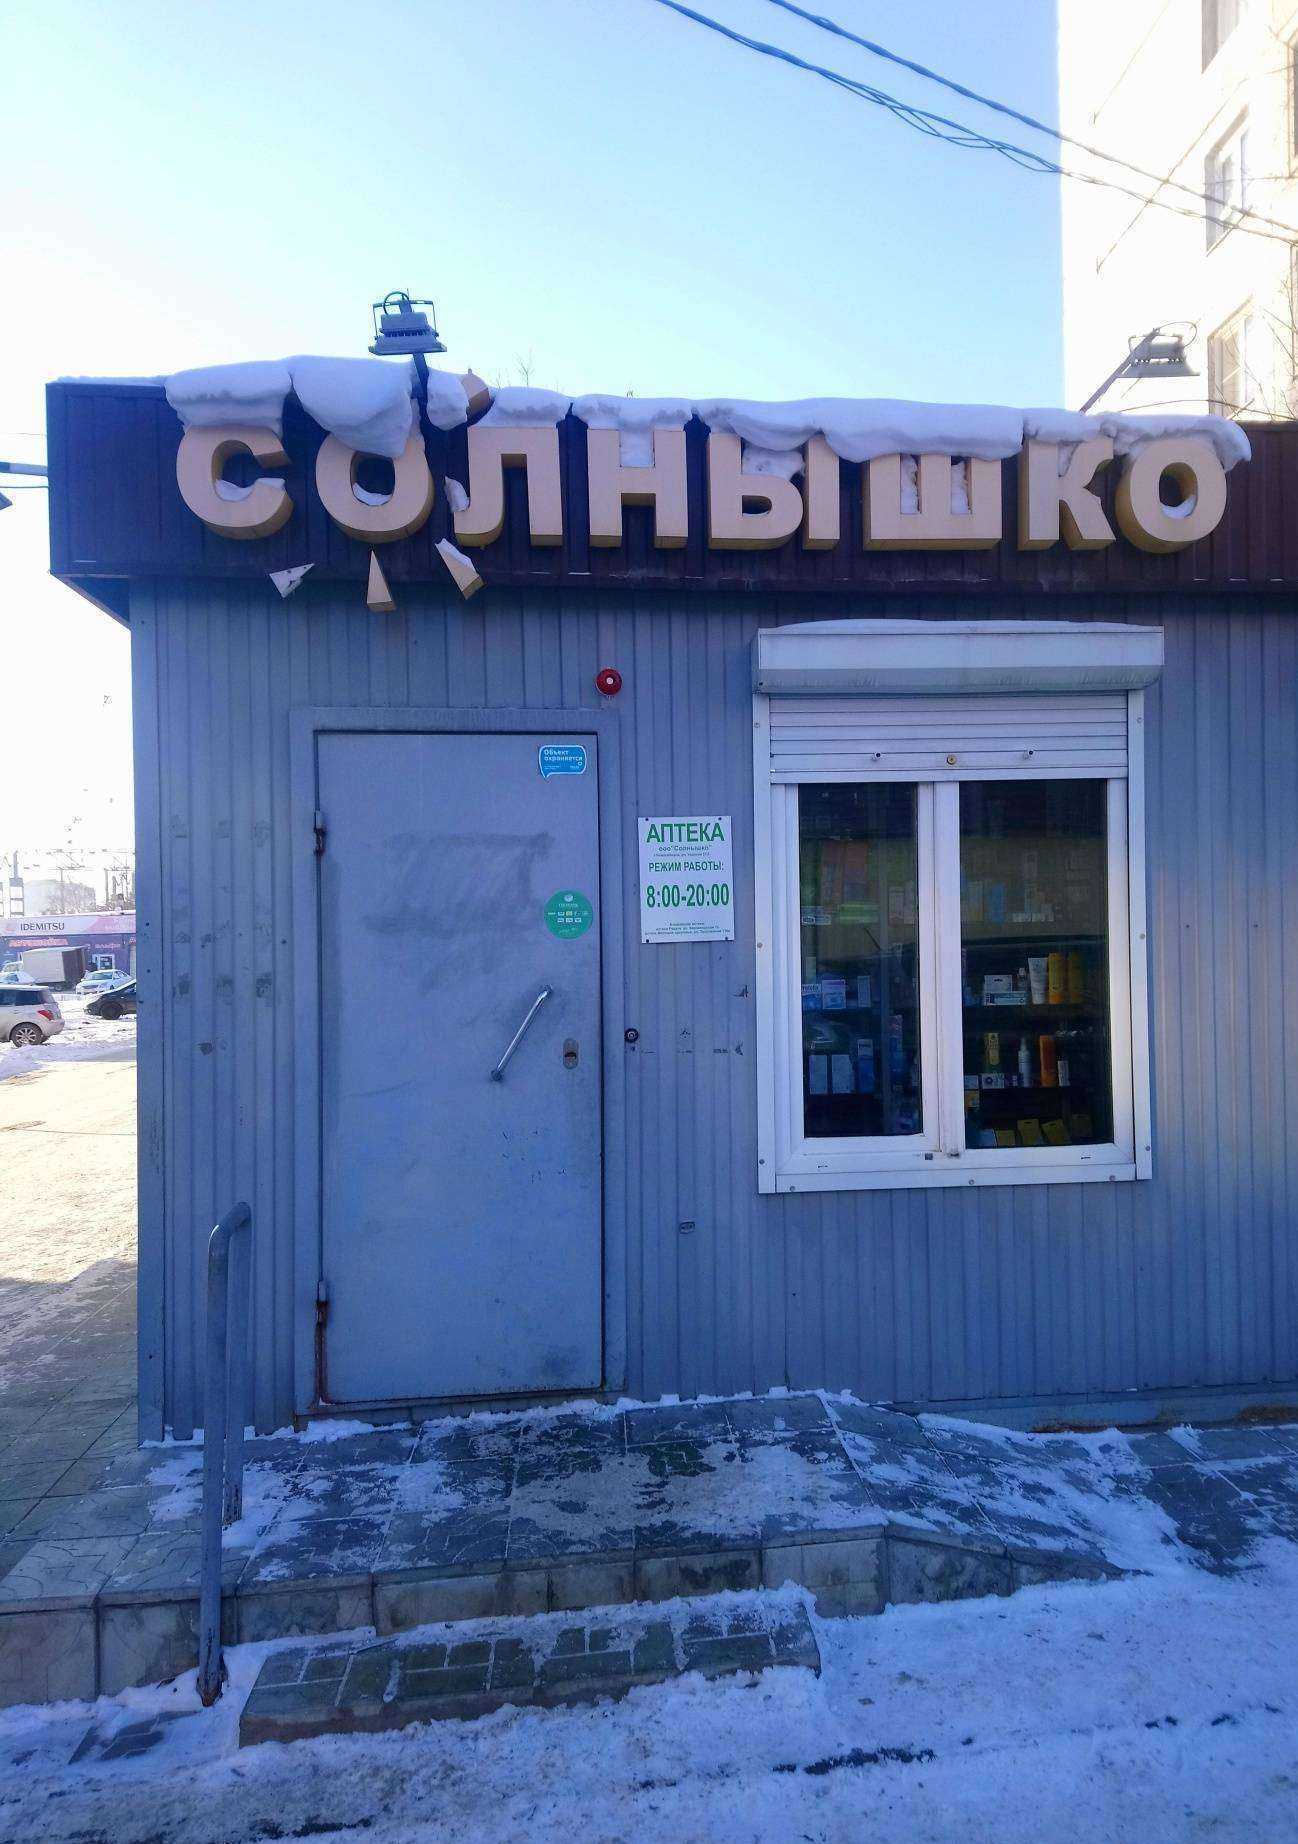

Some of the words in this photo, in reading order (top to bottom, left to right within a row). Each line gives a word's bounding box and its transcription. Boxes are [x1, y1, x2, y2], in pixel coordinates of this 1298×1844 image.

[176, 424, 1228, 552] СОЛНЫШКО
[646, 822, 725, 843] АПТЕКА
[648, 861, 682, 872] РЕЖИМ
[683, 860, 725, 871] РАБОТЫ:
[646, 883, 730, 908] 8:00-20:00
[20, 922, 65, 931] IDEMITSU
